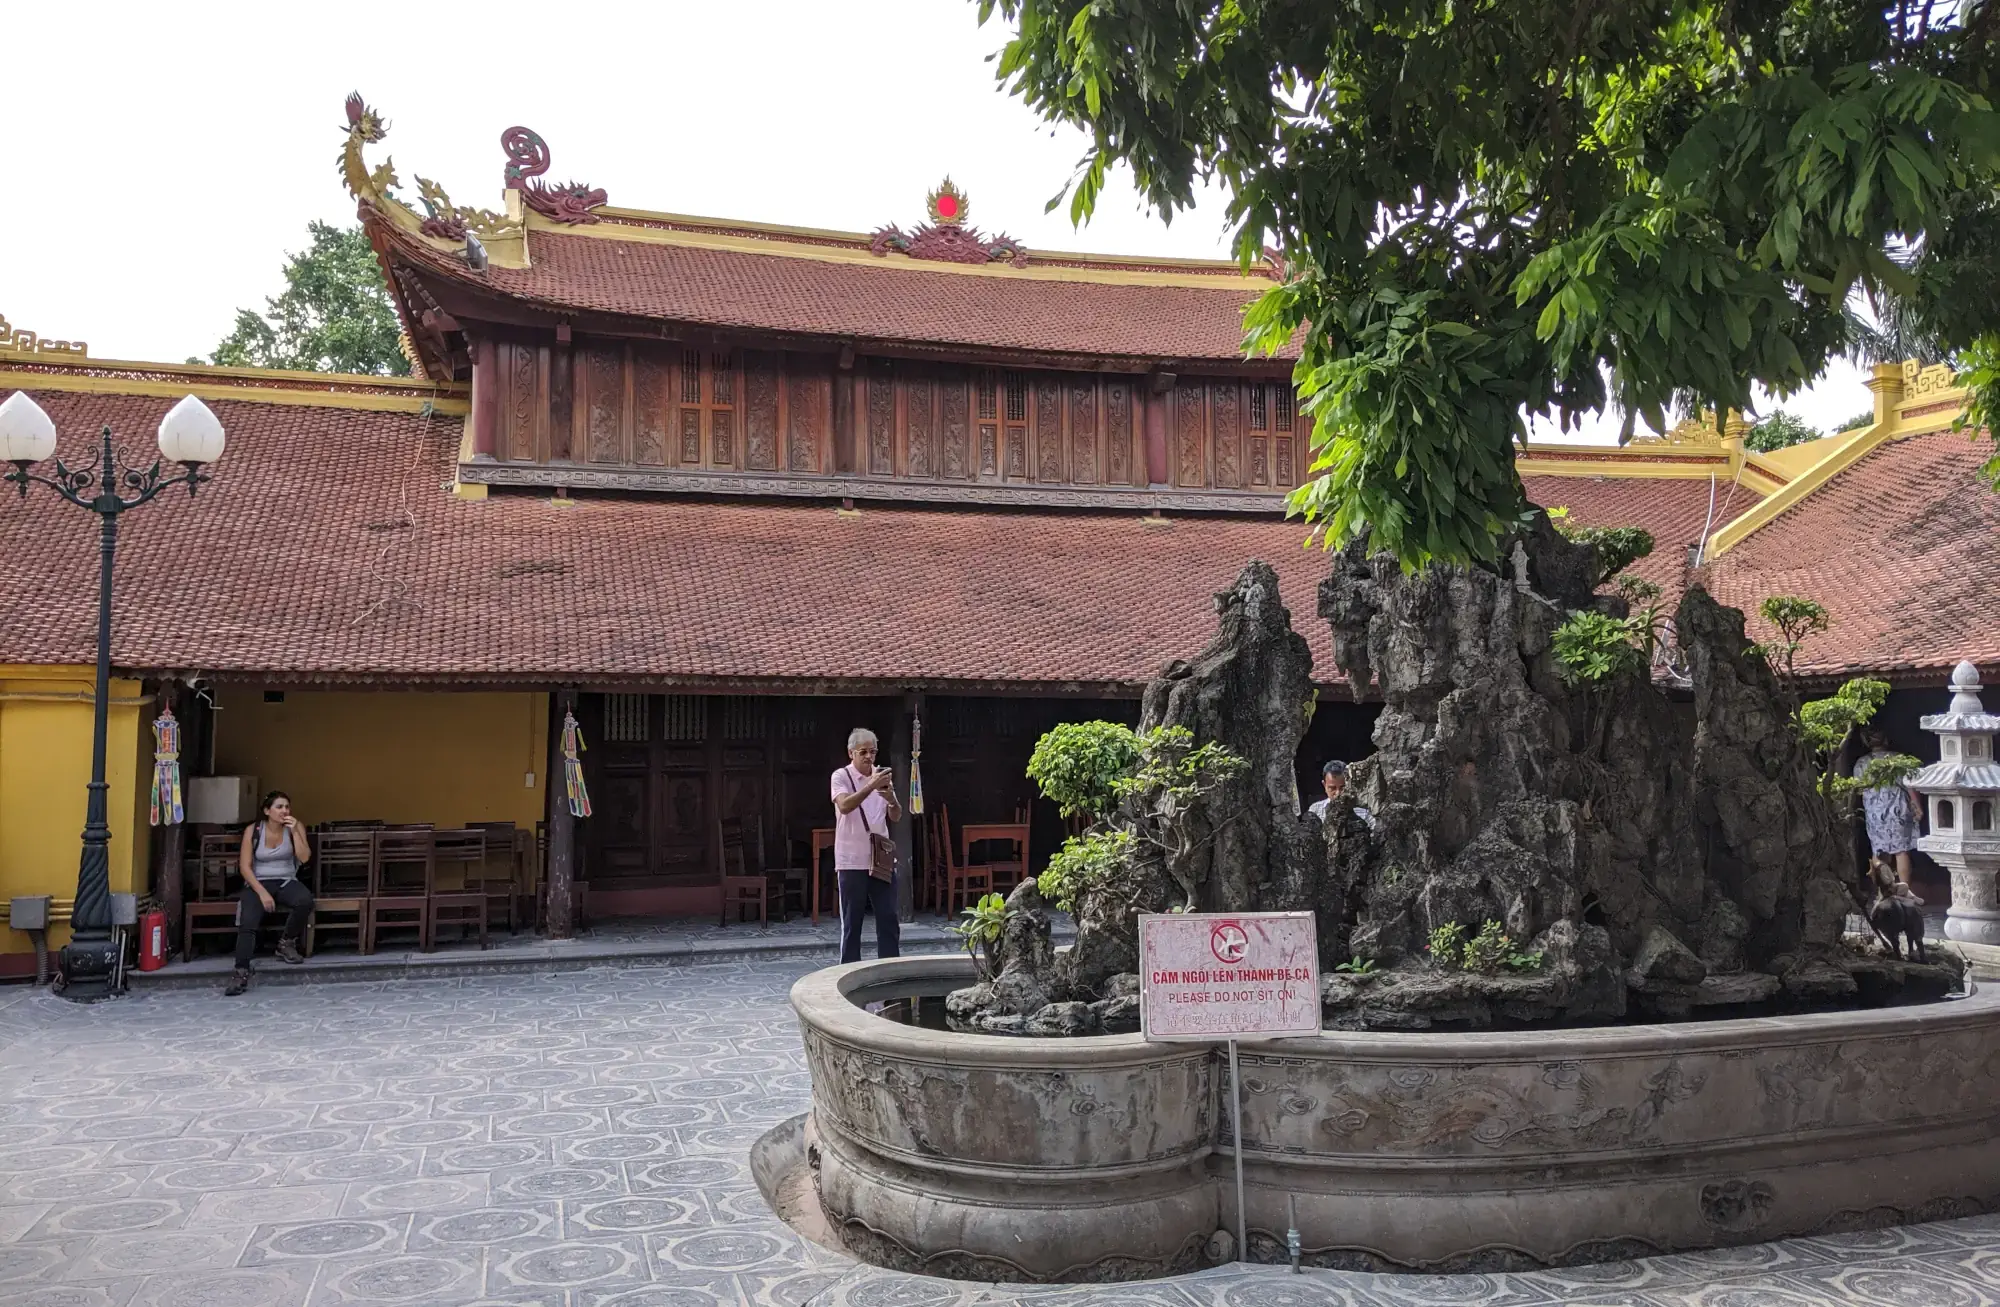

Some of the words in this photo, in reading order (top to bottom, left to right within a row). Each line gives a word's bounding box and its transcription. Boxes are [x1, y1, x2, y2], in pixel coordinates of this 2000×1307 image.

[1213, 967, 1234, 983] LÊN
[1168, 991, 1211, 1003] PLEASE
[1214, 991, 1230, 1002] DO
[1232, 990, 1254, 1001] NOT
[1257, 990, 1274, 1001] SIT
[1277, 989, 1296, 1001] ON!
